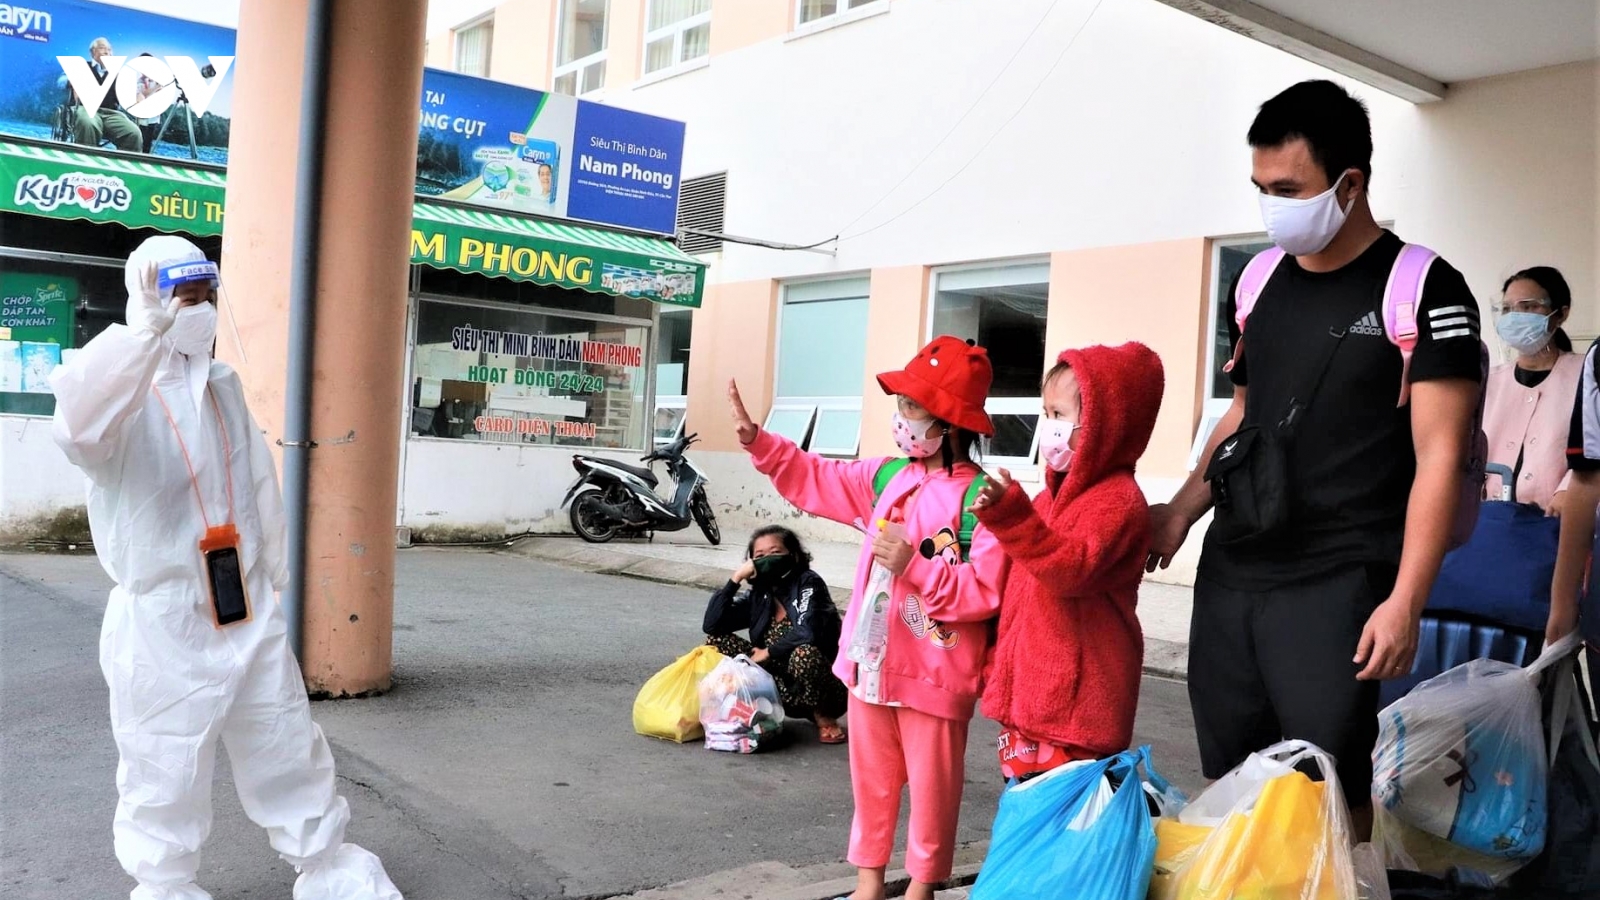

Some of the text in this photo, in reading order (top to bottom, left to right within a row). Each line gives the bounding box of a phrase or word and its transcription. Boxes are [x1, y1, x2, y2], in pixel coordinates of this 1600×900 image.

[425, 90, 446, 108] TẠI
[453, 117, 487, 139] CỤT
[590, 136, 668, 160] Siêu Thị Bình Dân
[579, 154, 618, 176] Nam
[621, 162, 673, 190] Phong
[150, 191, 197, 220] SIÊU
[180, 266, 203, 276] Face
[458, 237, 593, 285] PHONG
[25, 307, 46, 316] TAN
[1349, 325, 1382, 336] adidas
[452, 324, 642, 368] SIÊU THỊ MINI BÌNH DÂN NAM PHONG
[467, 365, 604, 392] HOẠT ĐỘNG 24/24
[474, 416, 514, 433] CARD
[555, 421, 597, 439] THOẠI
